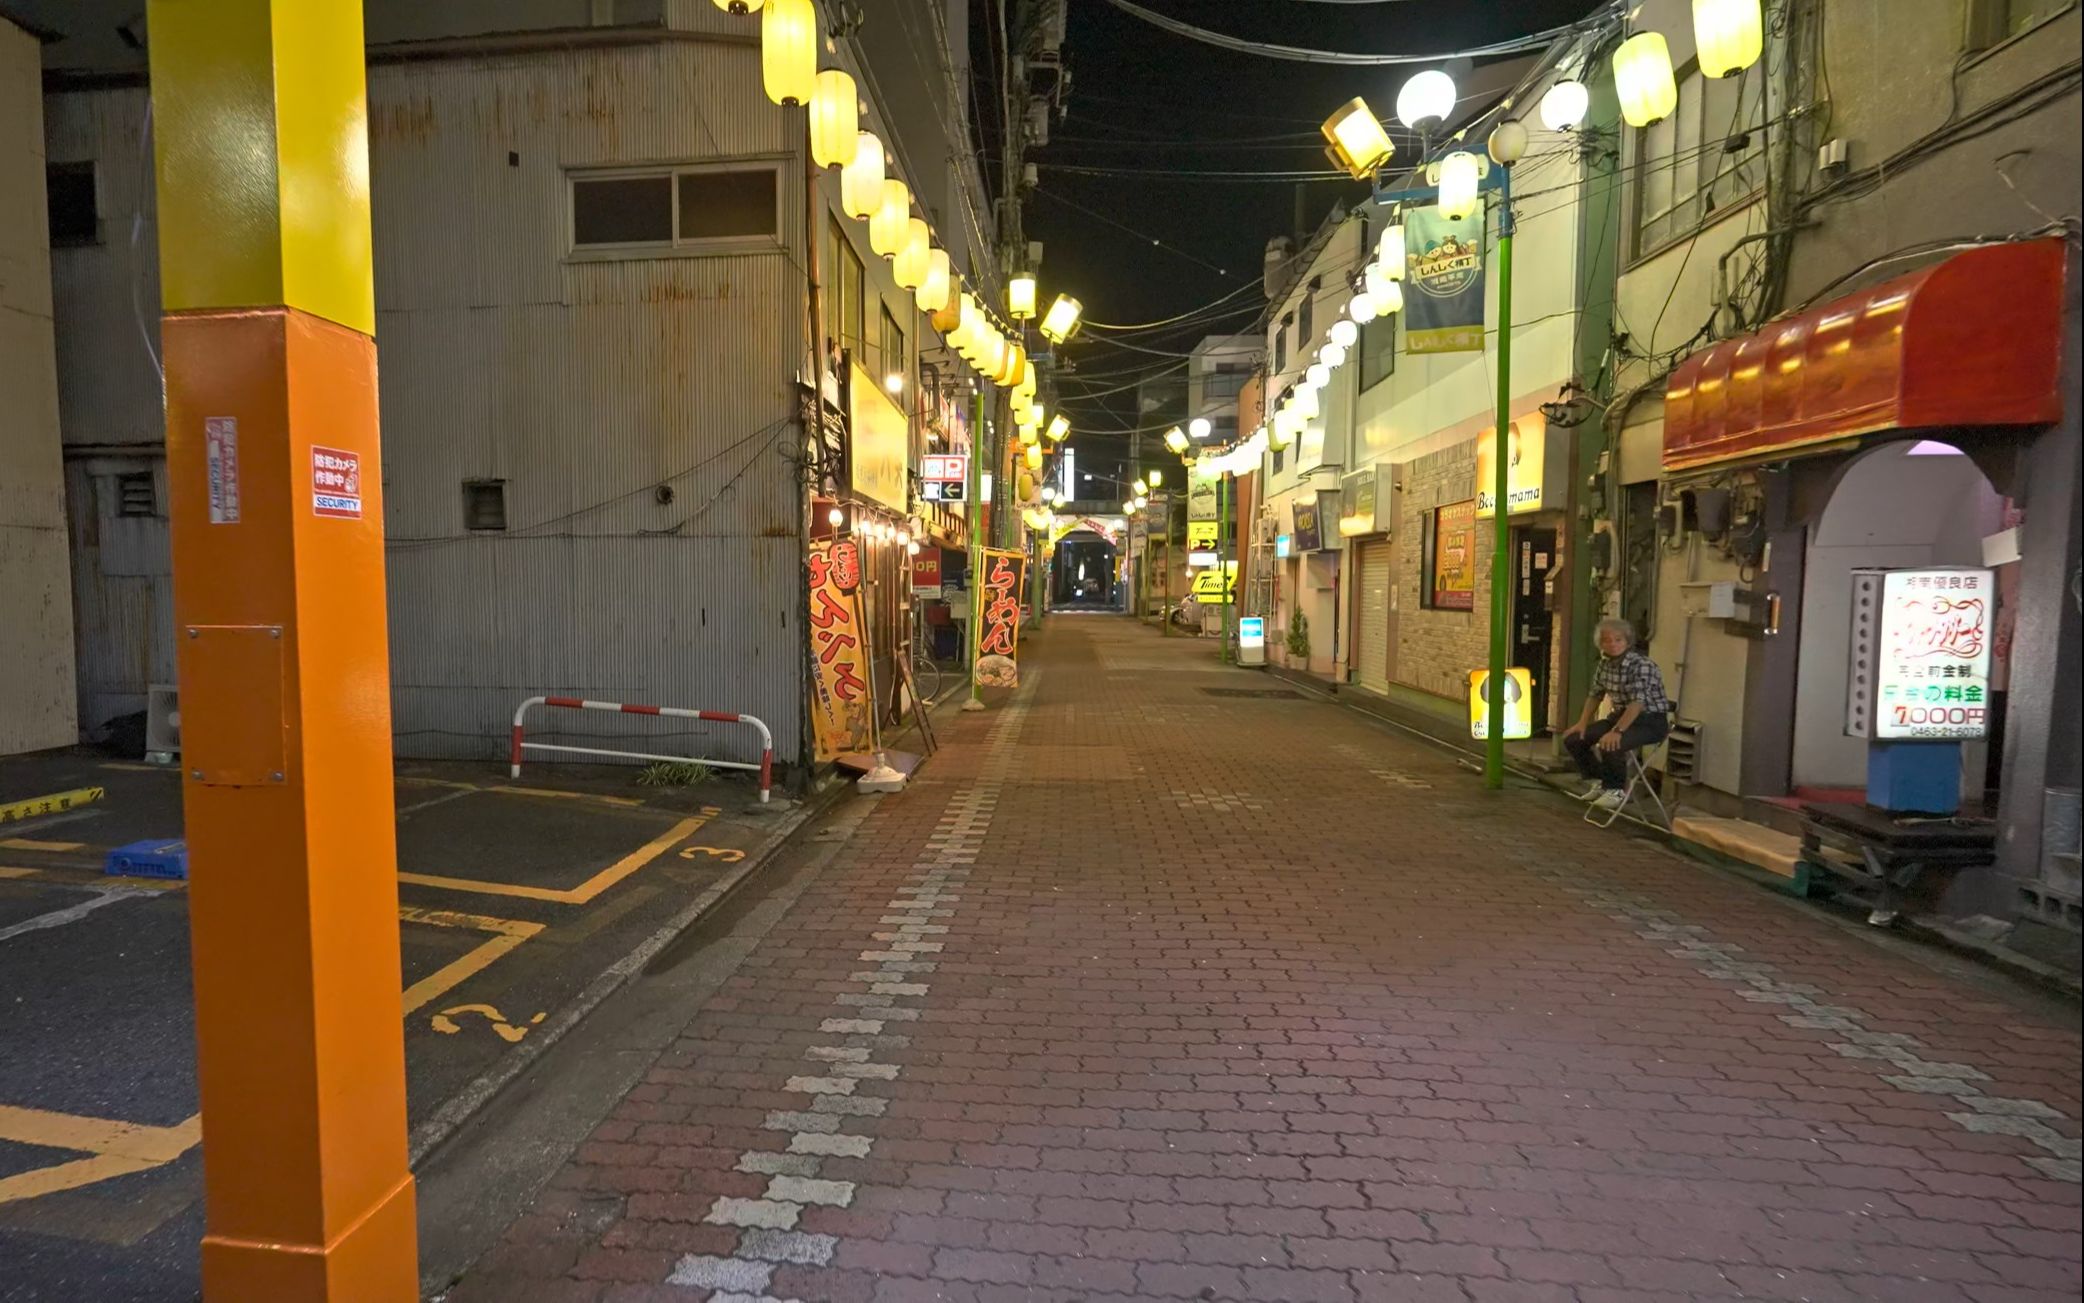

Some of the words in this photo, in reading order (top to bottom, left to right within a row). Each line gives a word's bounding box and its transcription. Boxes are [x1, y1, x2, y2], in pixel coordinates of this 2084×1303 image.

[1420, 257, 1472, 276] しんしく横丁
[314, 453, 357, 472] 防犯カメラ
[316, 496, 358, 510] SECURITY
[1508, 487, 1540, 504] mama
[1191, 539, 1200, 550] P
[912, 560, 937, 573] 0円
[981, 556, 1020, 655] らーめん
[679, 846, 746, 862] 3
[431, 1003, 547, 1043] 2
